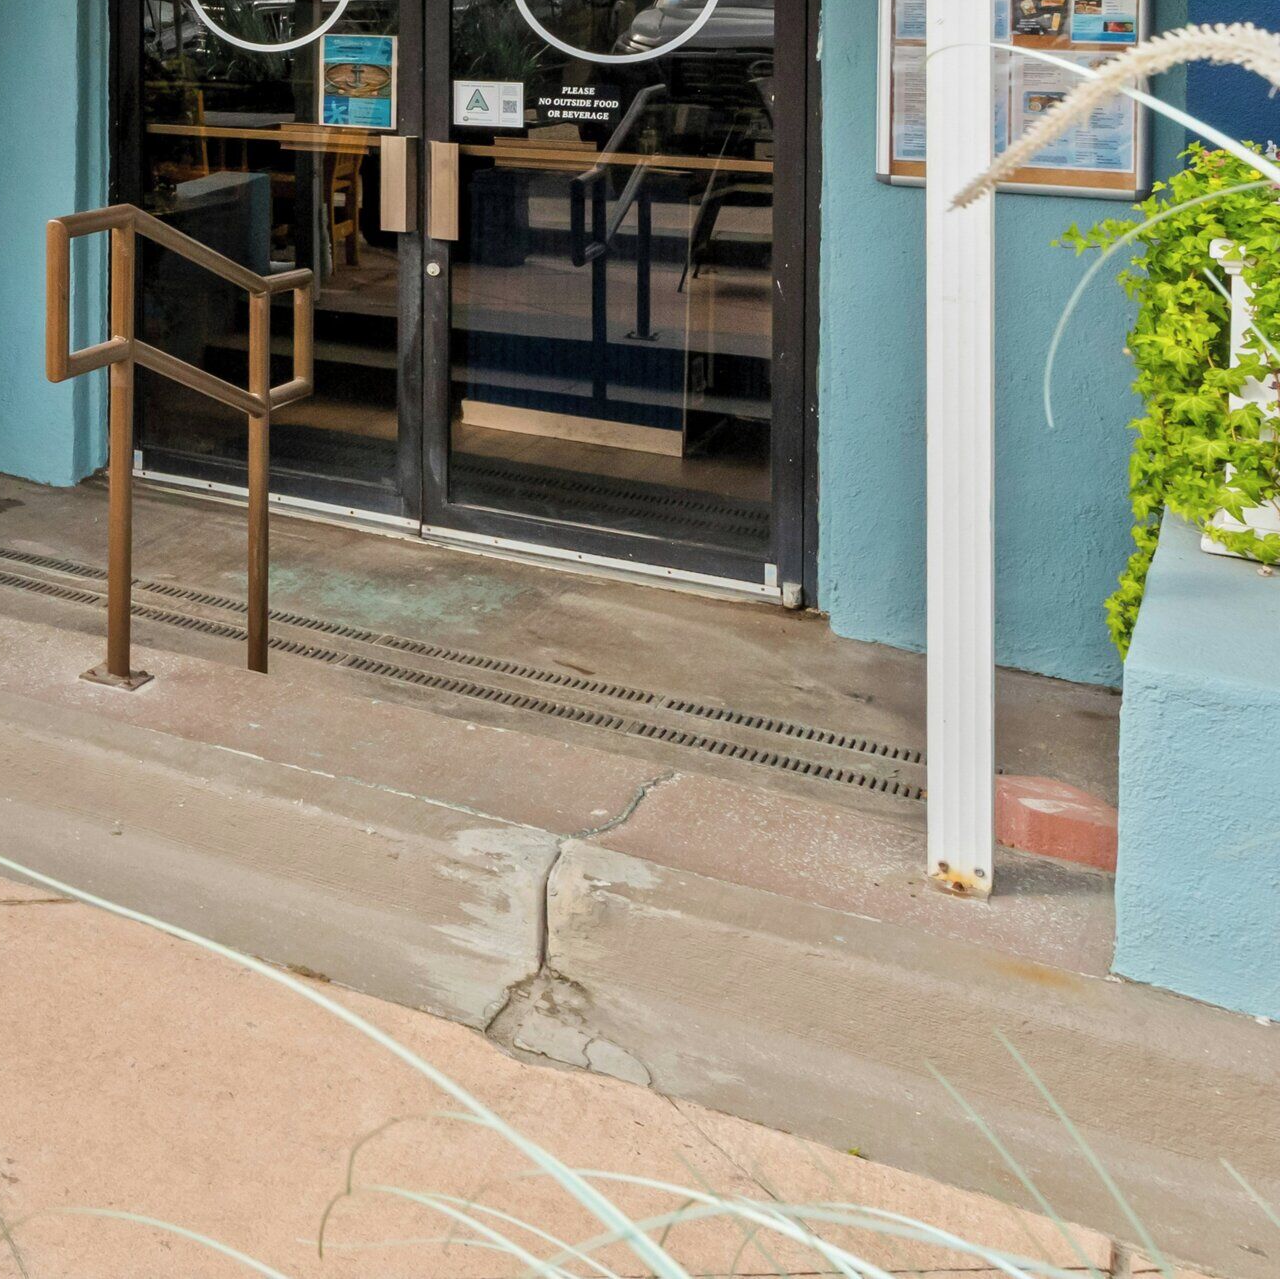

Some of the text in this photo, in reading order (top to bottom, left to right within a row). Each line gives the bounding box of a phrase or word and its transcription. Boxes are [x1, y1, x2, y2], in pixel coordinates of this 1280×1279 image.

[561, 86, 596, 96] PLEASE
[466, 88, 490, 112] A
[538, 97, 619, 109] NO OUTSIDE FOOD
[547, 109, 610, 120] OR BEVERAGE
